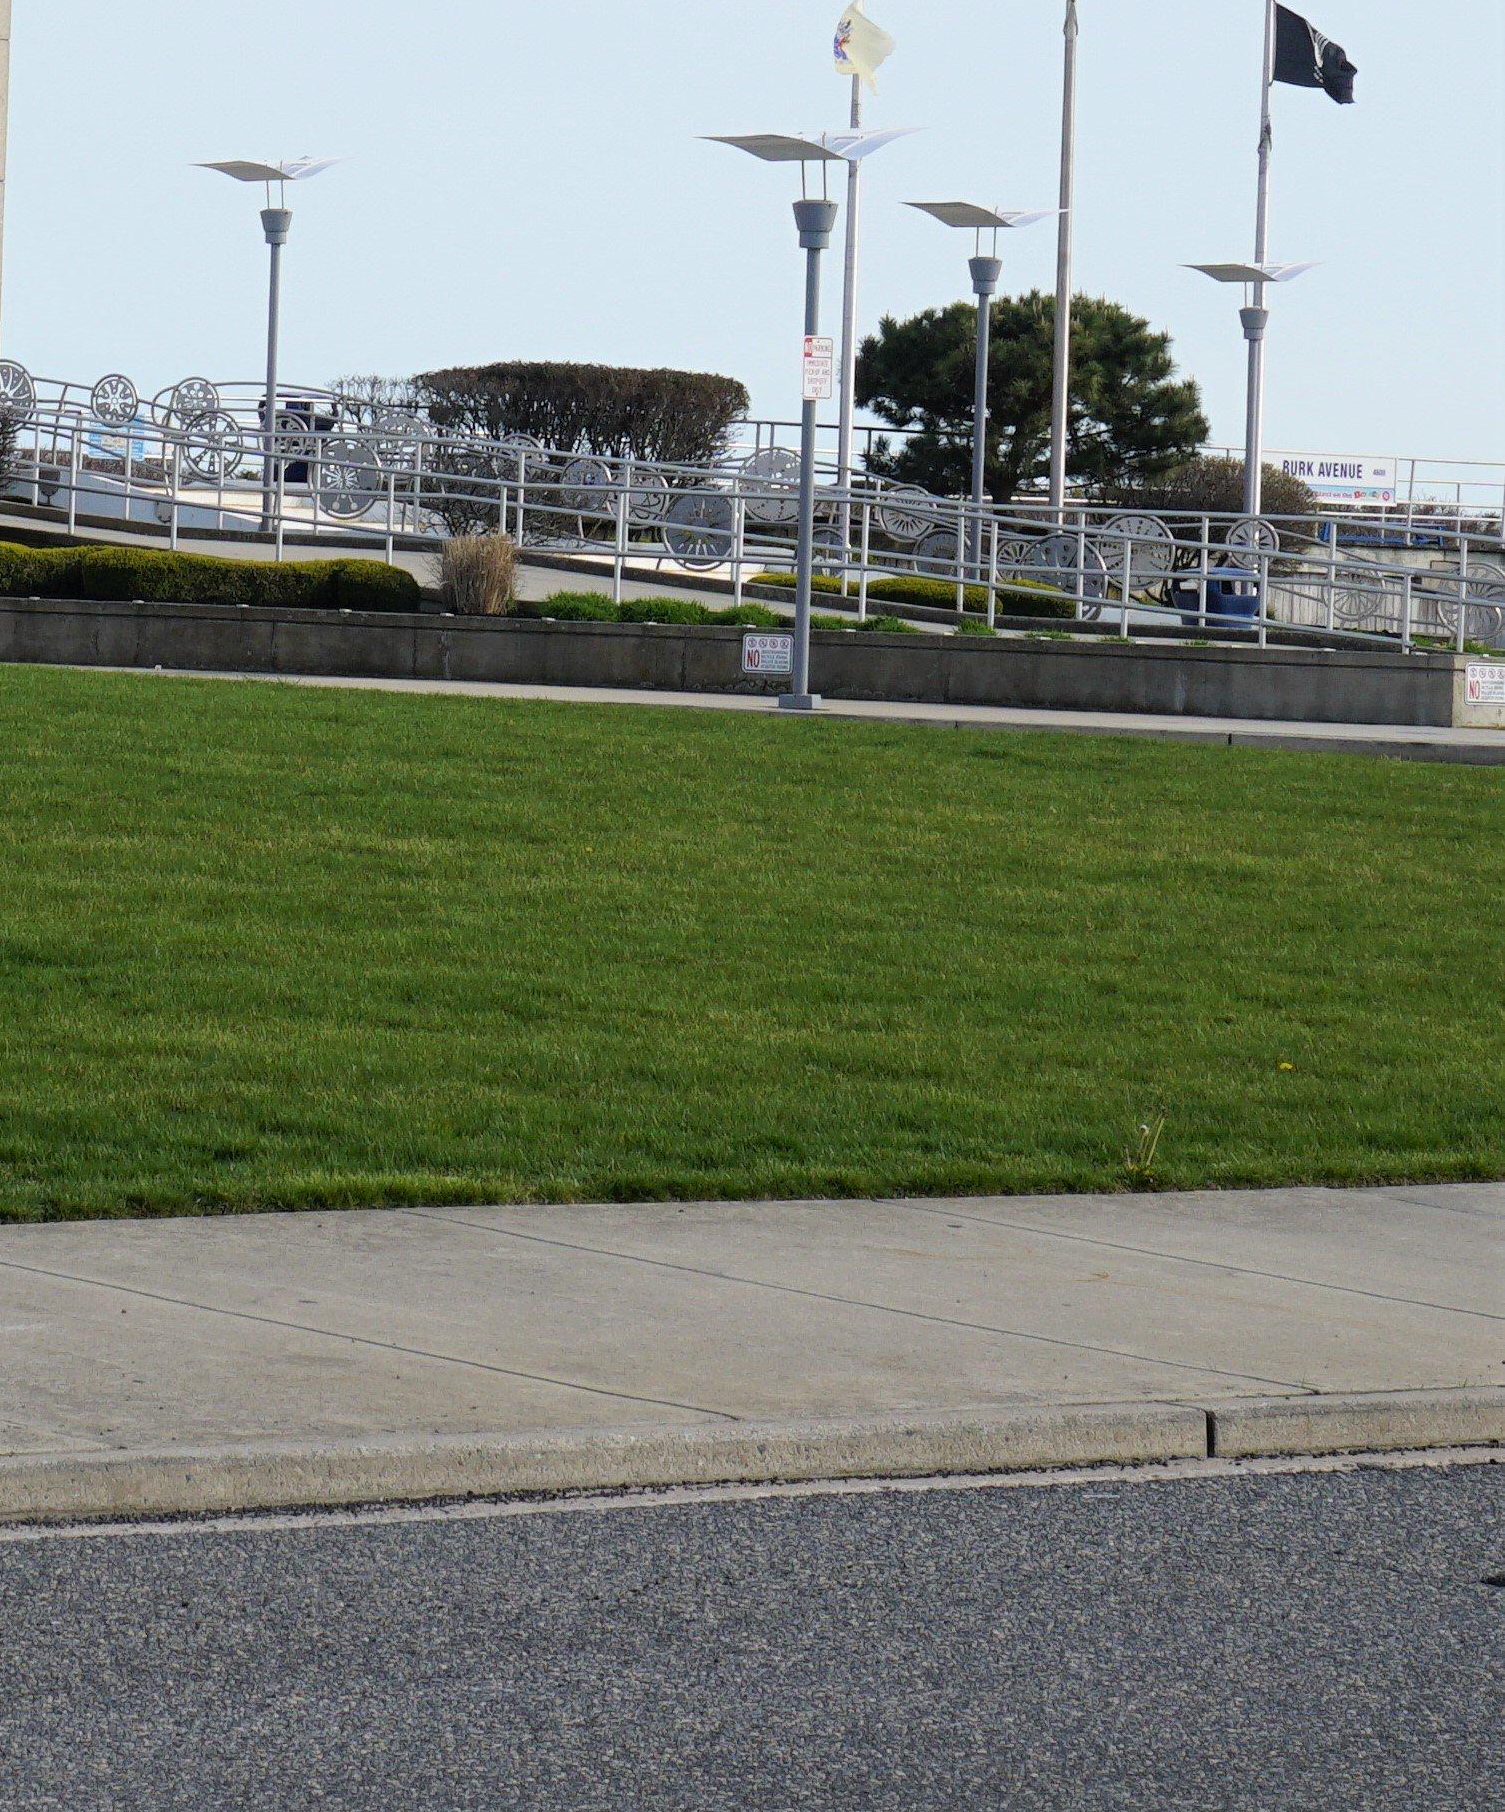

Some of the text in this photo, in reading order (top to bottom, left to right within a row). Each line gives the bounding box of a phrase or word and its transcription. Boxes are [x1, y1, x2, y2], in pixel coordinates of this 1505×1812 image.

[1282, 460, 1314, 476] BURK
[1318, 461, 1363, 479] AVENUE
[747, 649, 760, 668] NO
[1469, 680, 1481, 700] NO
